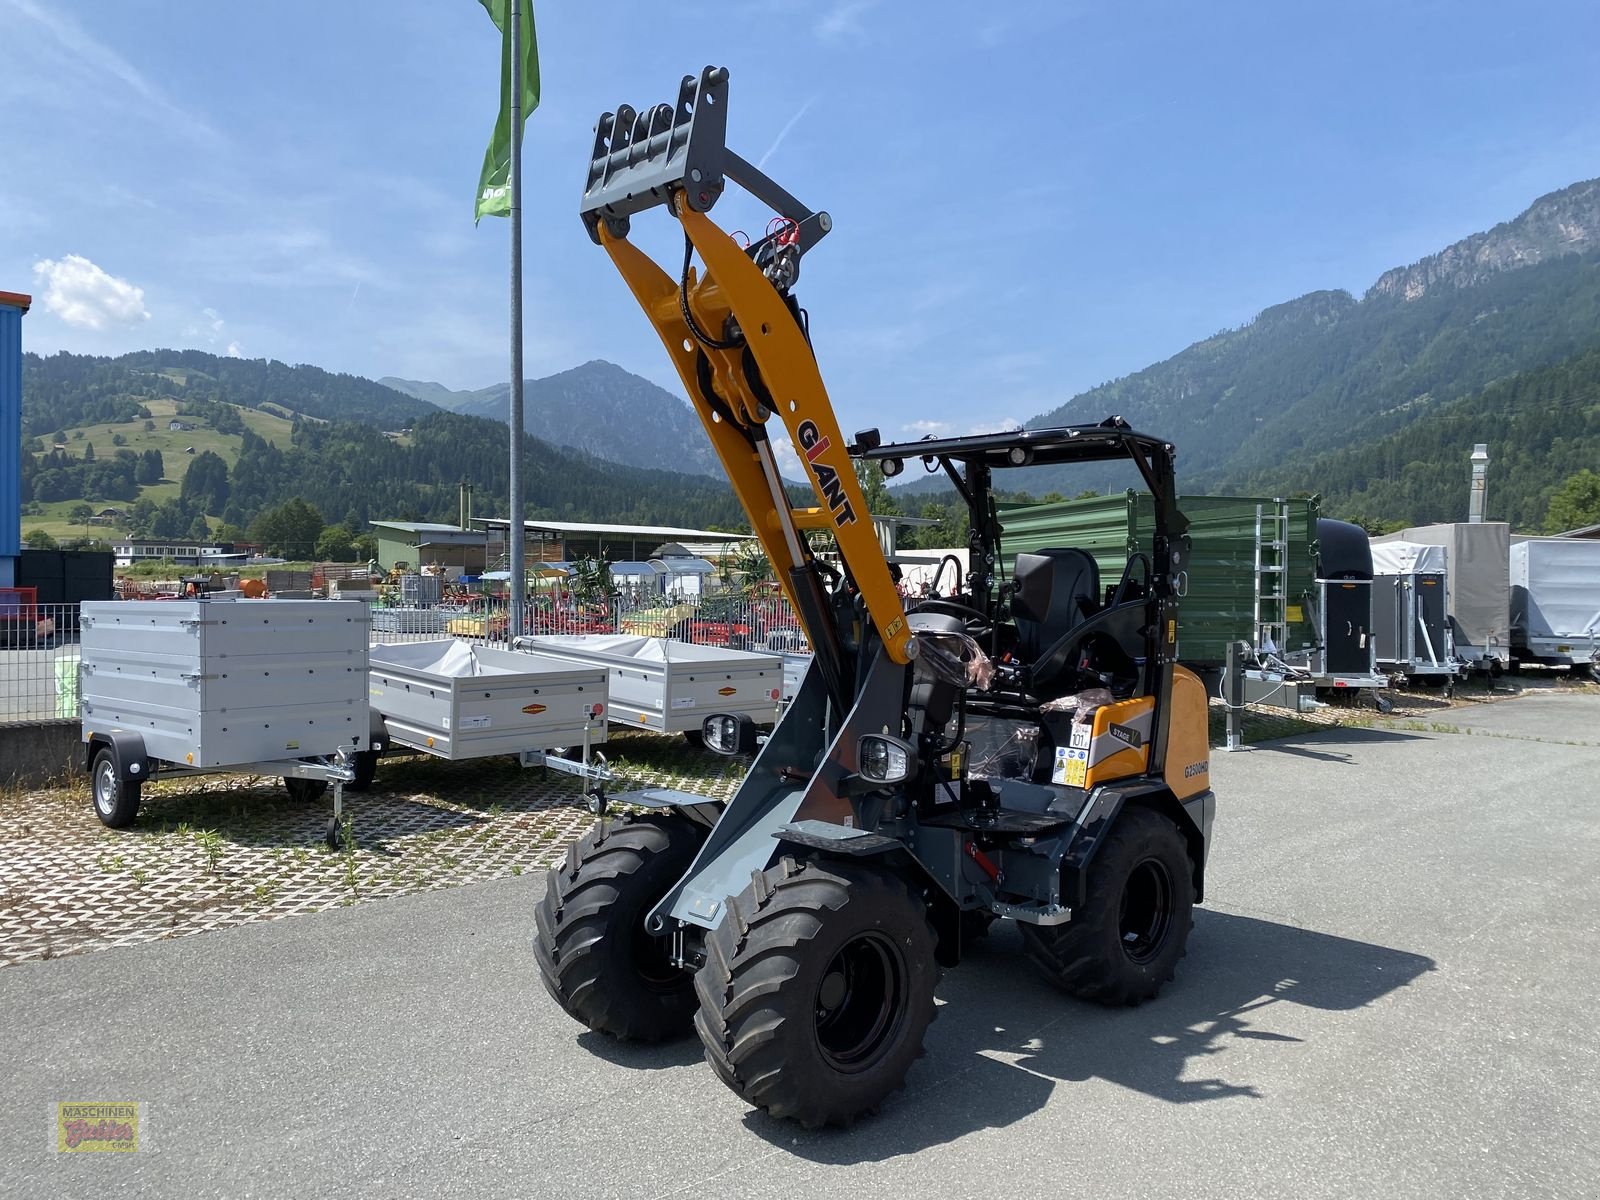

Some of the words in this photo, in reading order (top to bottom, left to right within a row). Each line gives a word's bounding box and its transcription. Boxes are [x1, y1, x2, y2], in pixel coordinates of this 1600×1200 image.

[797, 419, 858, 528] GIANT
[1072, 733, 1084, 747] 101
[1113, 728, 1130, 742] STAGE
[1185, 761, 1208, 778] G2500HD
